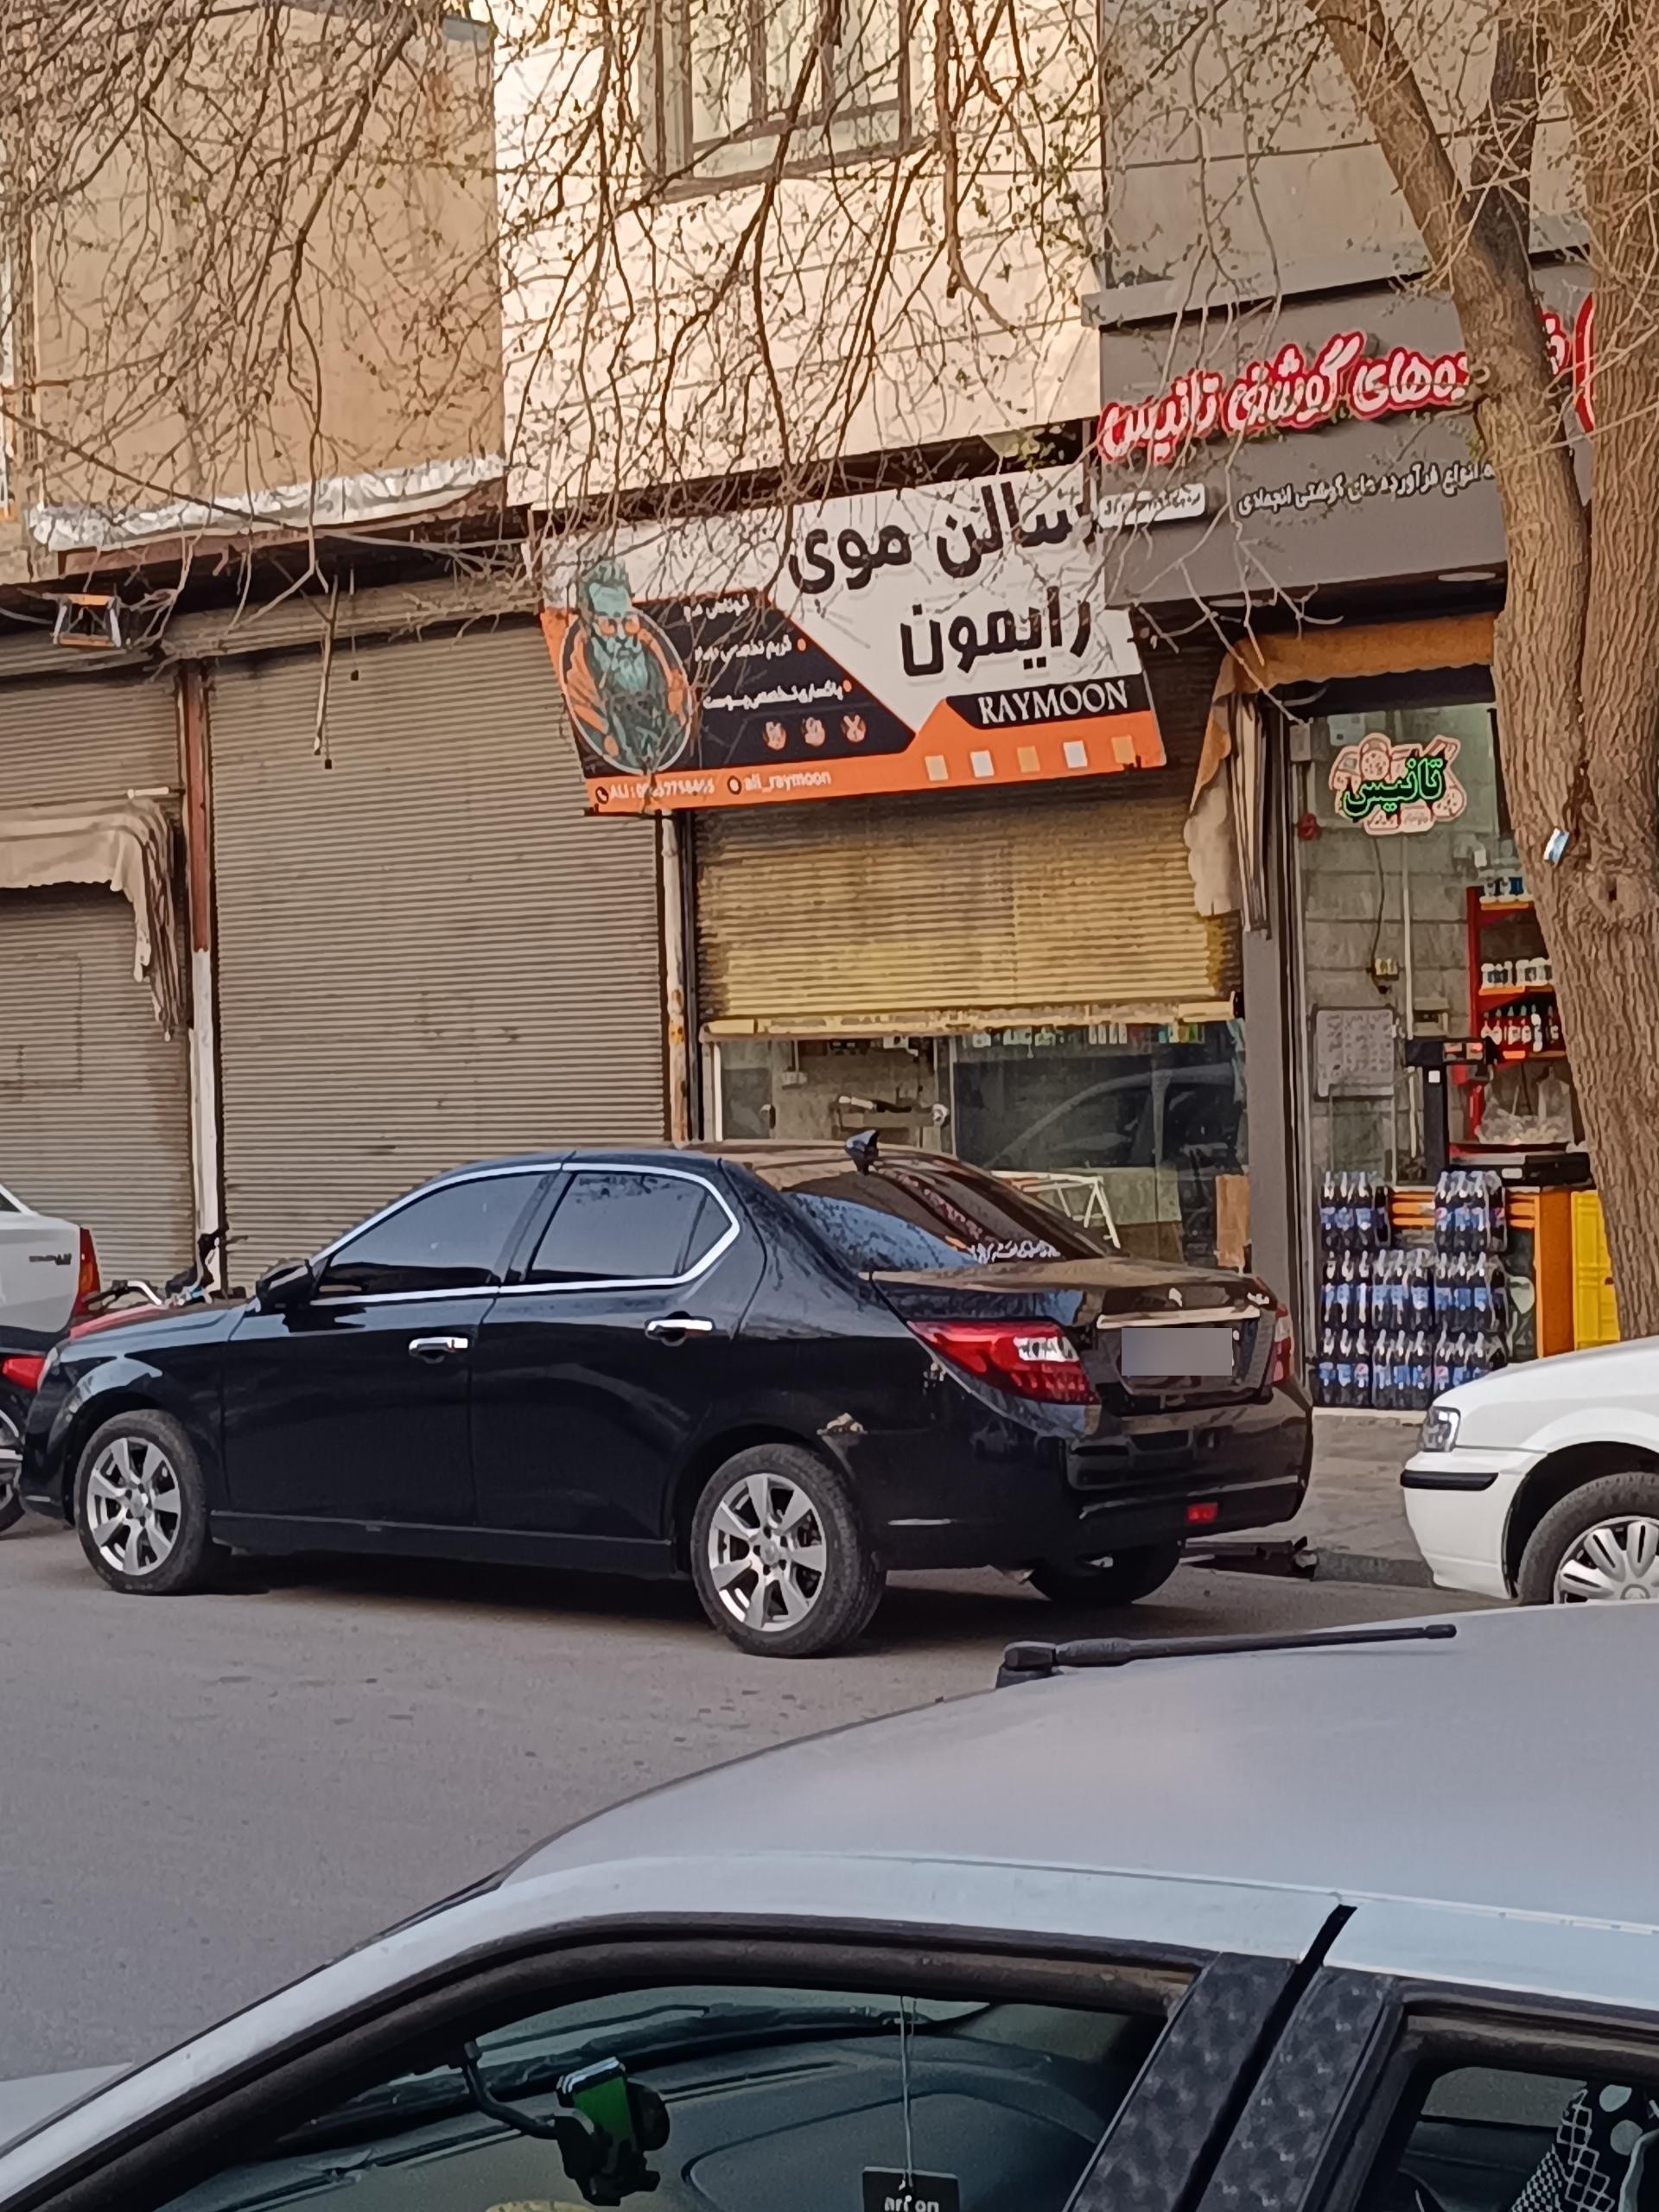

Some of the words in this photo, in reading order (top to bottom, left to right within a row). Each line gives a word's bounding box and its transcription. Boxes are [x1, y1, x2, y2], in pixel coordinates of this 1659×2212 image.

[788, 524, 912, 594] موی
[937, 480, 1084, 579] سالن
[900, 585, 1091, 677] رایمون
[977, 679, 1128, 725] RAYMOON
[742, 770, 832, 792] ali_raymoon
[1343, 757, 1444, 817] تانیس
